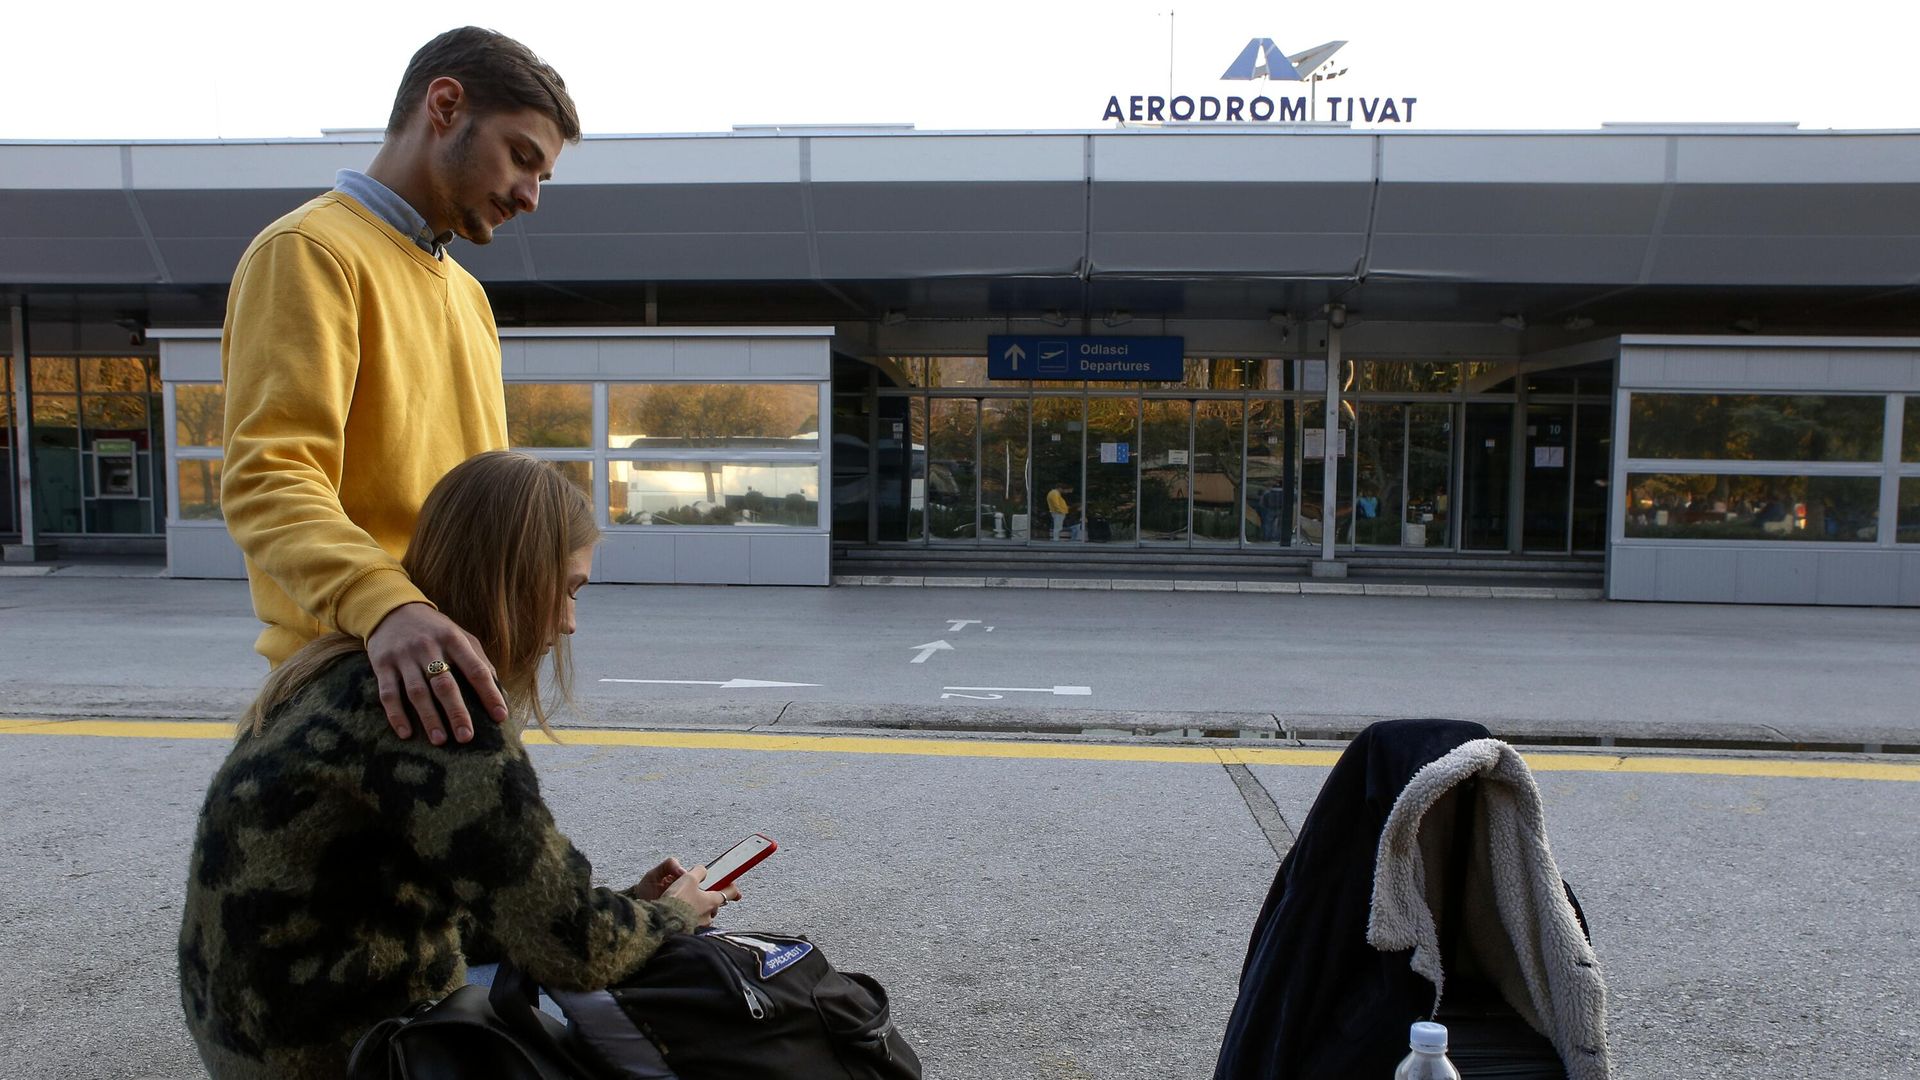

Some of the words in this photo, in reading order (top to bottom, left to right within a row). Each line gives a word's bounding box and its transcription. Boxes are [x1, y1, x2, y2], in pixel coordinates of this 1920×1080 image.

[1102, 96, 1306, 121] AERODROM
[1327, 97, 1417, 122] TIVAT
[1080, 344, 1128, 355] Odlasci
[1080, 360, 1150, 373] Departures
[1550, 425, 1561, 434] 10
